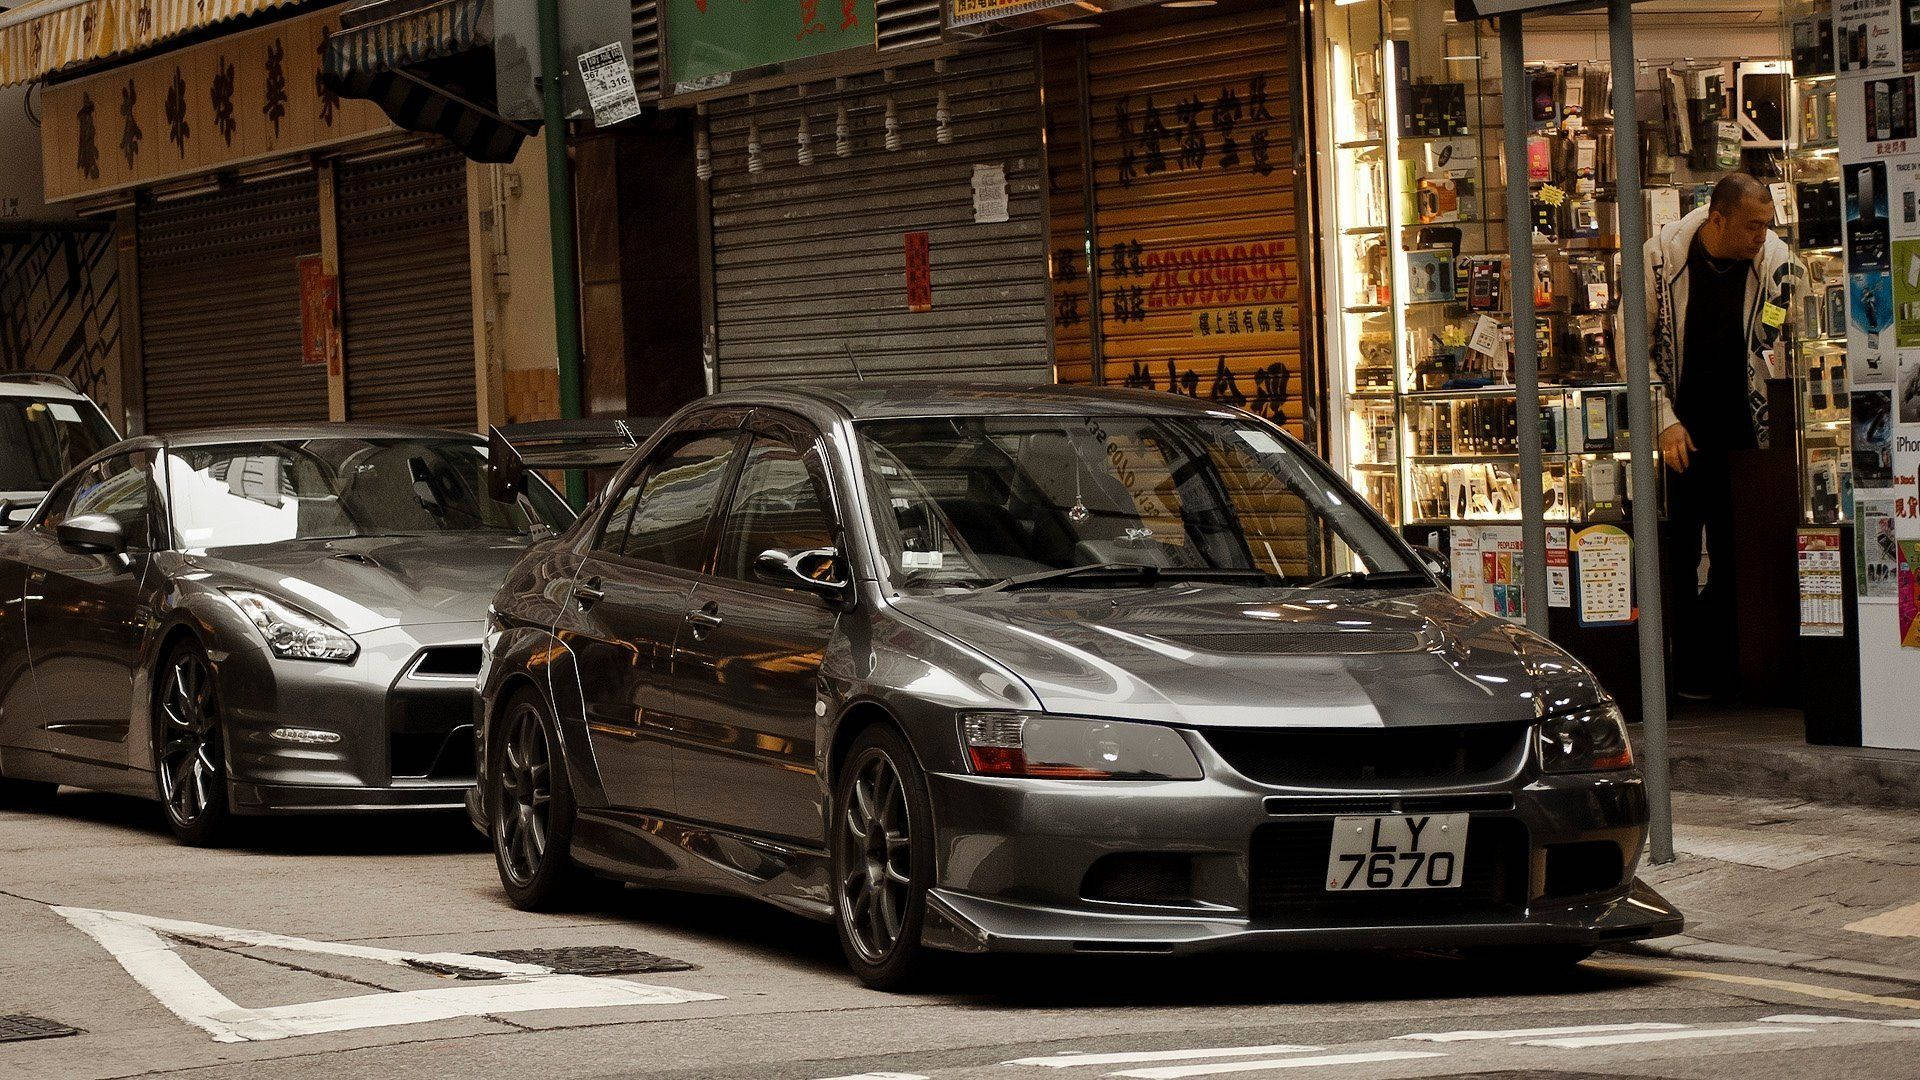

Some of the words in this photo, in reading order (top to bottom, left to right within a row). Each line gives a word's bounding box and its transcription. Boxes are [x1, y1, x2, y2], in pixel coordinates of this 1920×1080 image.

[584, 70, 599, 81] 367
[610, 75, 628, 88] 316
[1895, 496, 1918, 519] 現貨
[1339, 852, 1454, 889] 7670
